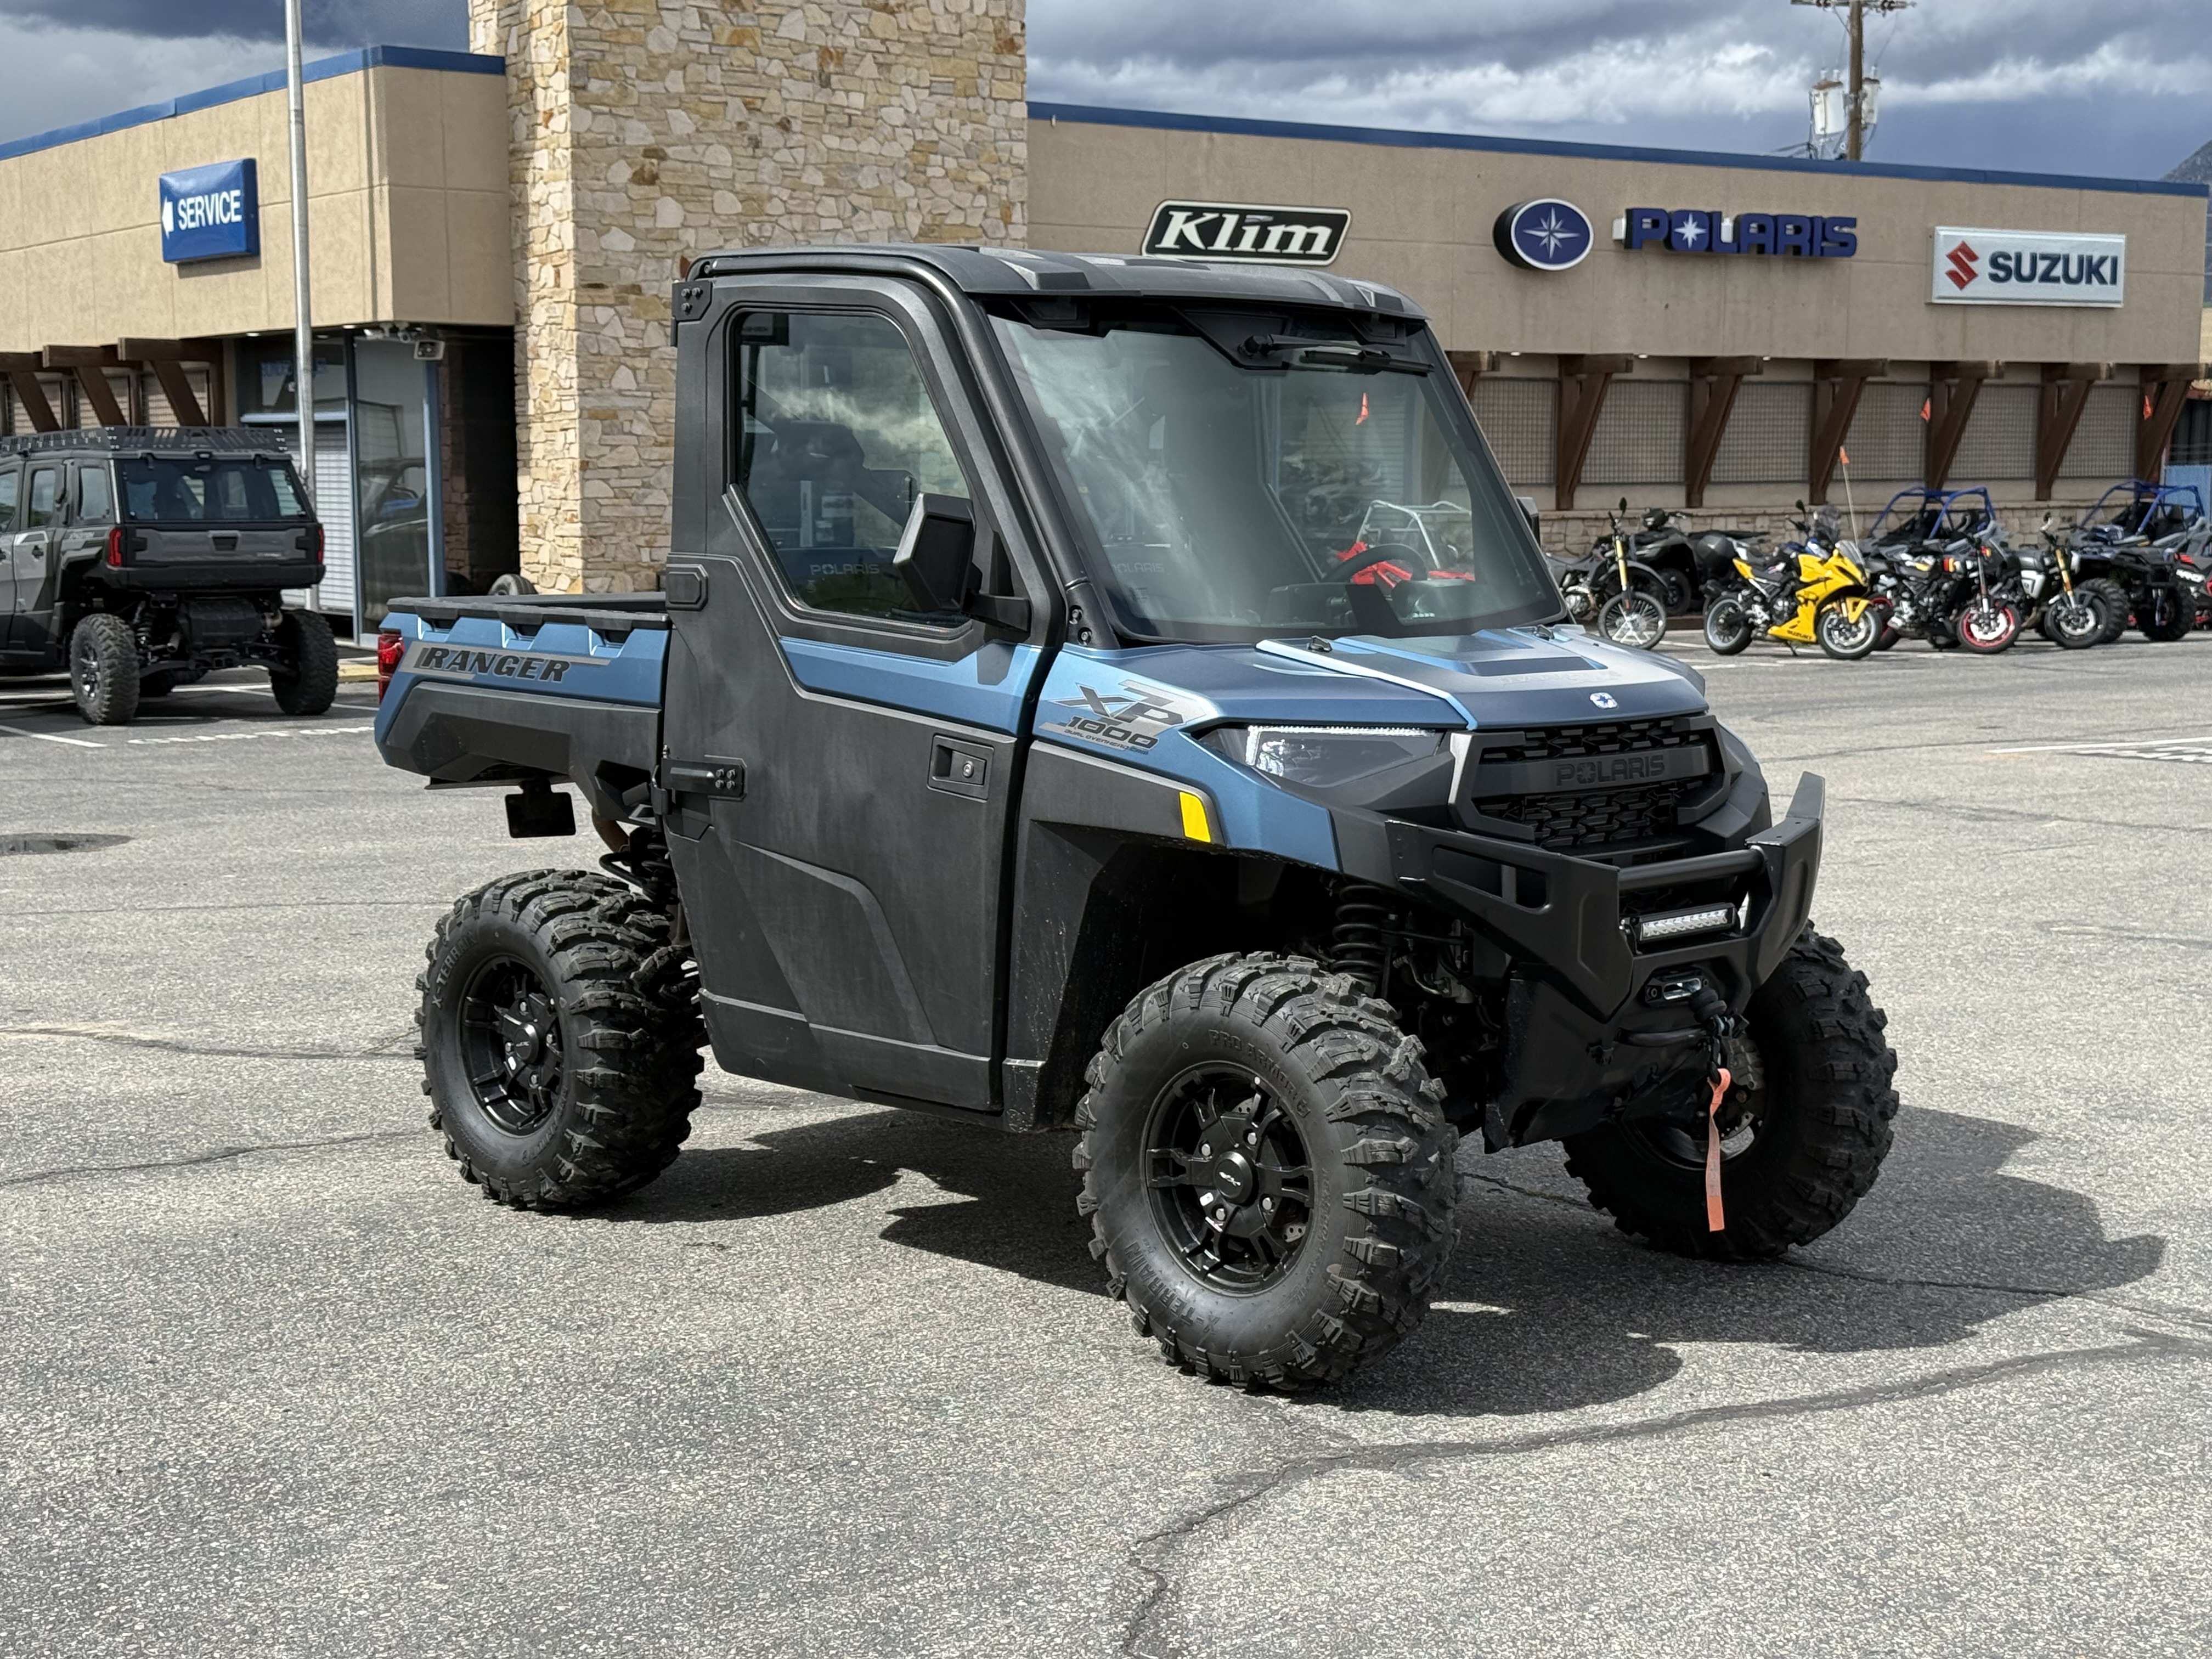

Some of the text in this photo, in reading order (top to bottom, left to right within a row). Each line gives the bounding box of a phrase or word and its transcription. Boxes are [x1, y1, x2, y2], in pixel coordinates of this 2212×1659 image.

[177, 189, 242, 230] SERVICE
[1626, 208, 1857, 257] POLARIS
[1987, 250, 2118, 285] SUZUKI
[810, 563, 880, 575] POLARIS
[420, 646, 572, 682] RANGER
[1054, 683, 1185, 726] XP
[1064, 729, 1084, 738] DUAL
[1068, 716, 1159, 749] 1000
[1556, 754, 1665, 786] POLARIS
[431, 930, 479, 1009] X-TERRAIN
[1207, 1029, 1243, 1052] PRO
[1124, 1240, 1221, 1335] X-TERRAIN
